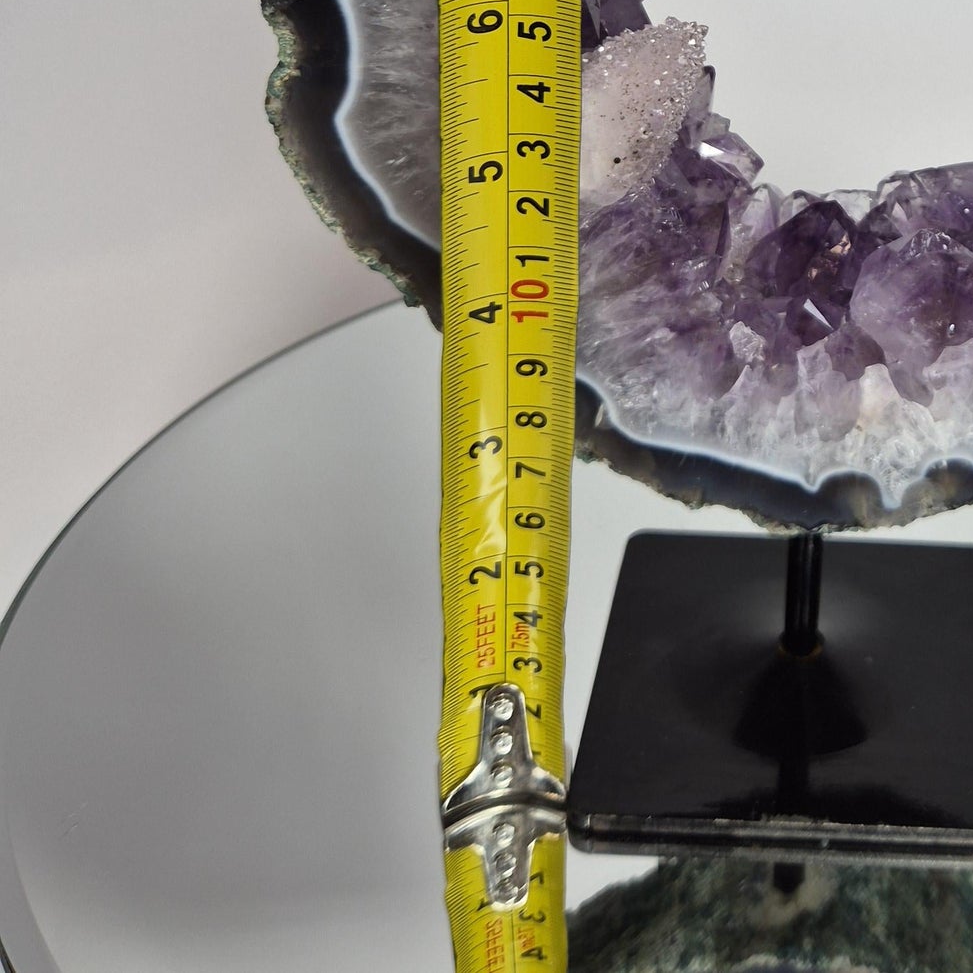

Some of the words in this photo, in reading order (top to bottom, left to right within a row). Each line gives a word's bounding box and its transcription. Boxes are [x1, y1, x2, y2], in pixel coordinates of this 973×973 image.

[467, 9, 504, 34] 6
[517, 21, 552, 42] 5
[516, 81, 551, 104] 4
[516, 139, 550, 160] 3
[468, 160, 504, 184] 5
[516, 196, 550, 217] 2
[515, 254, 550, 268] 1
[510, 279, 550, 323] 10
[469, 301, 503, 324] 4
[515, 358, 548, 377] 9
[515, 411, 548, 429] 8
[469, 435, 503, 460] 3
[515, 461, 546, 479] 7
[514, 512, 546, 530] 6
[469, 561, 502, 585] 2
[514, 561, 545, 579] 5
[513, 610, 543, 627] 4
[477, 604, 496, 669] 25FEET
[513, 656, 542, 674] 3
